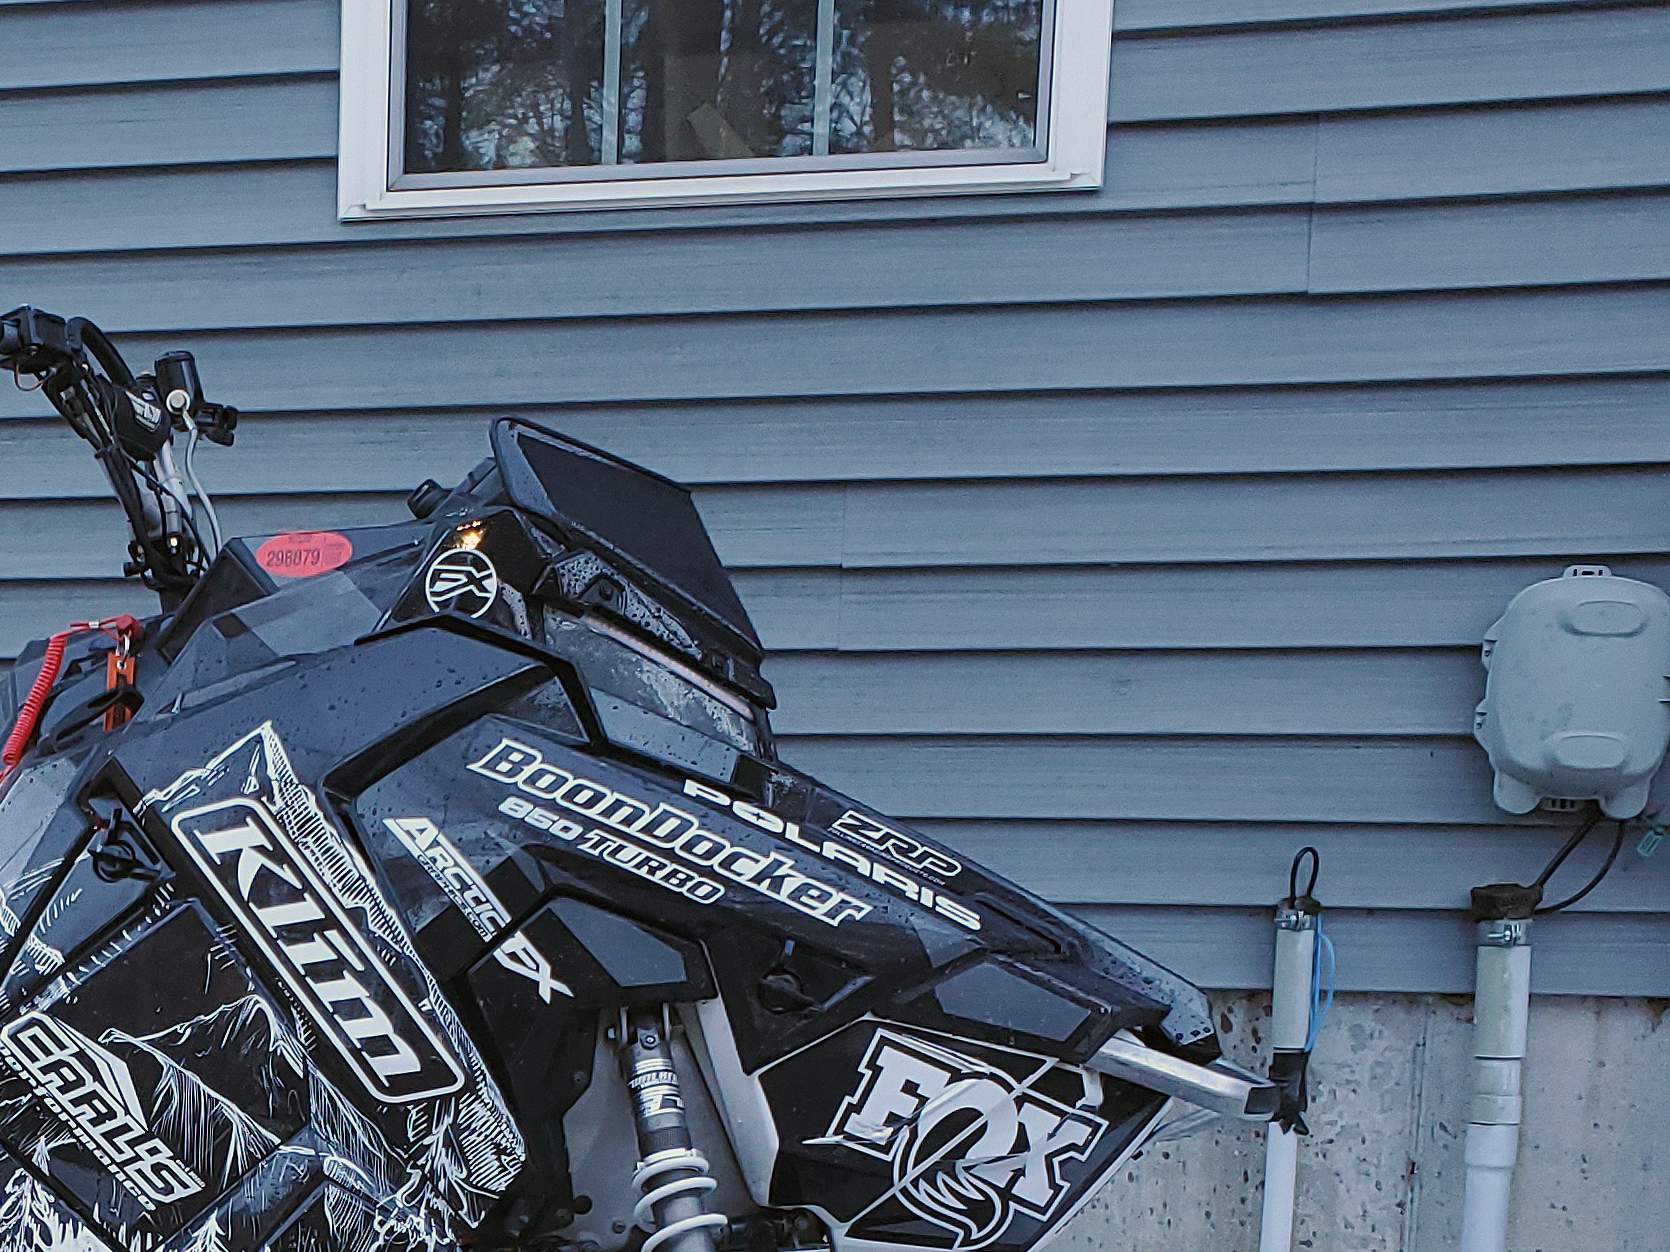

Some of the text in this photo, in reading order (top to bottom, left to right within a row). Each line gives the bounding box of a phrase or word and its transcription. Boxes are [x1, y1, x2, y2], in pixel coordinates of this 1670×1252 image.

[497, 797, 726, 904] 850 TURBO
[683, 779, 982, 931] POLARIS
[831, 809, 963, 877] ZRP
[827, 1028, 1109, 1222] FOX
